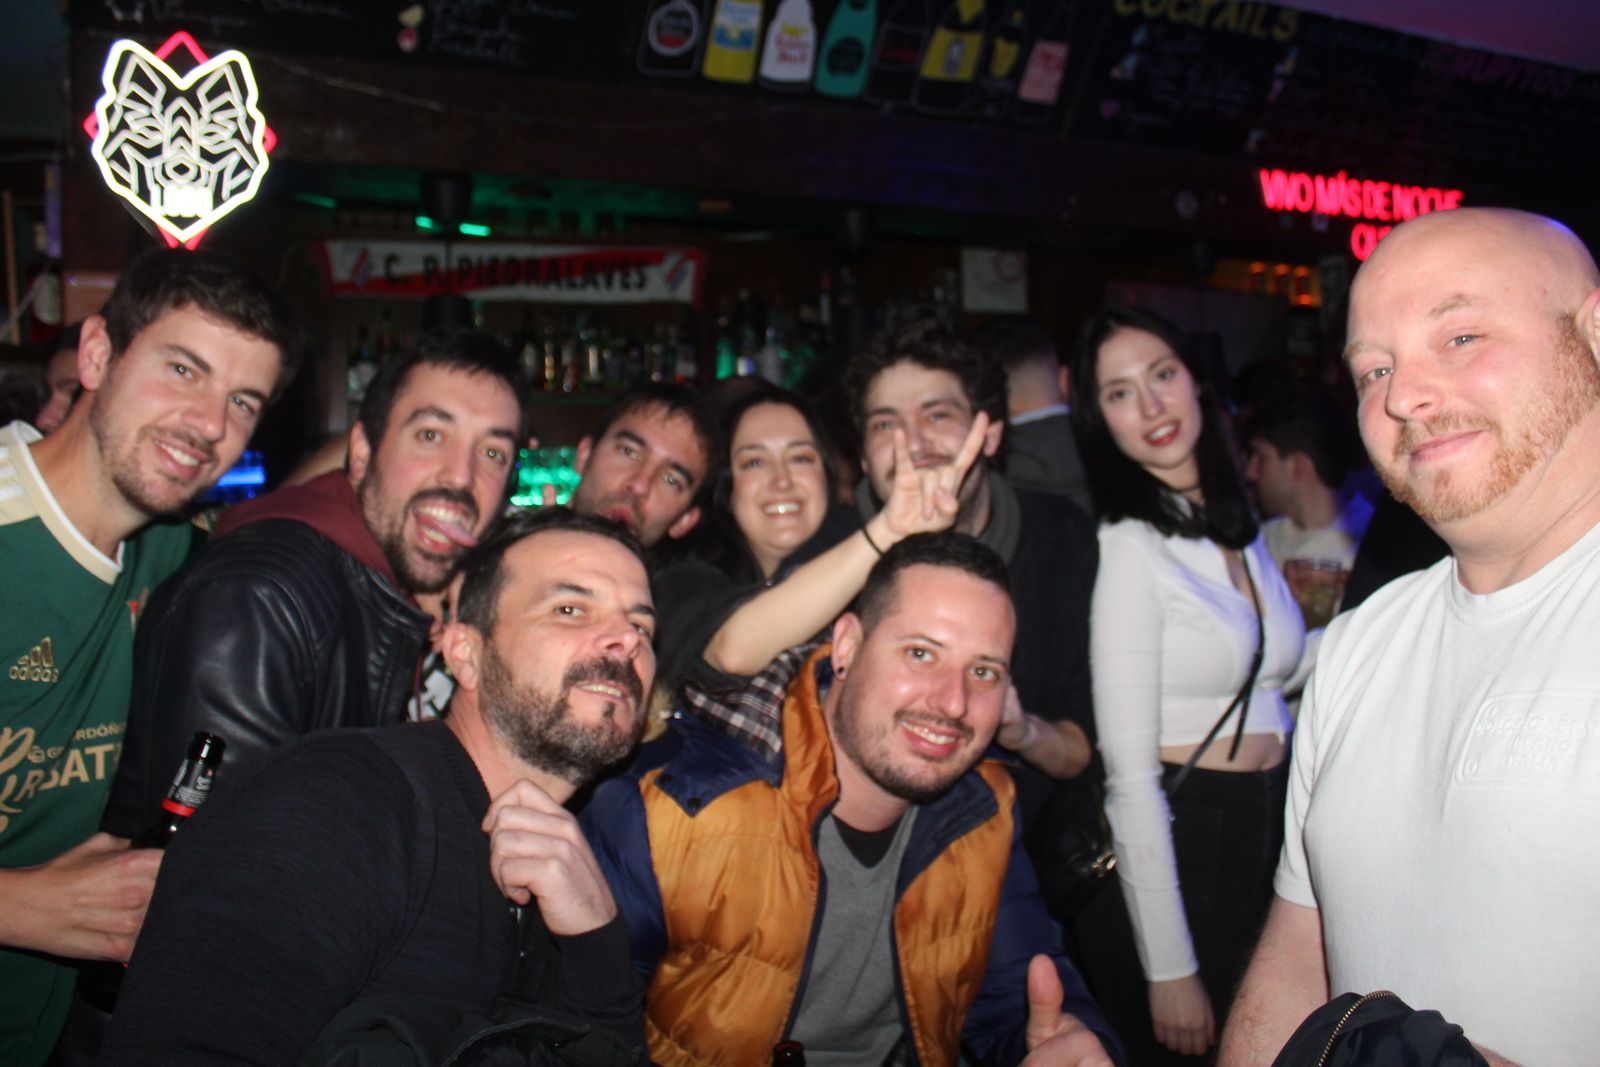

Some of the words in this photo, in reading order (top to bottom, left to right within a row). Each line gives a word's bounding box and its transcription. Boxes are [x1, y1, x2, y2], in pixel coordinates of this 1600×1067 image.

[1361, 180, 1392, 220] DE
[457, 256, 648, 291] PIEDRALAVES
[9, 664, 60, 684] adidas
